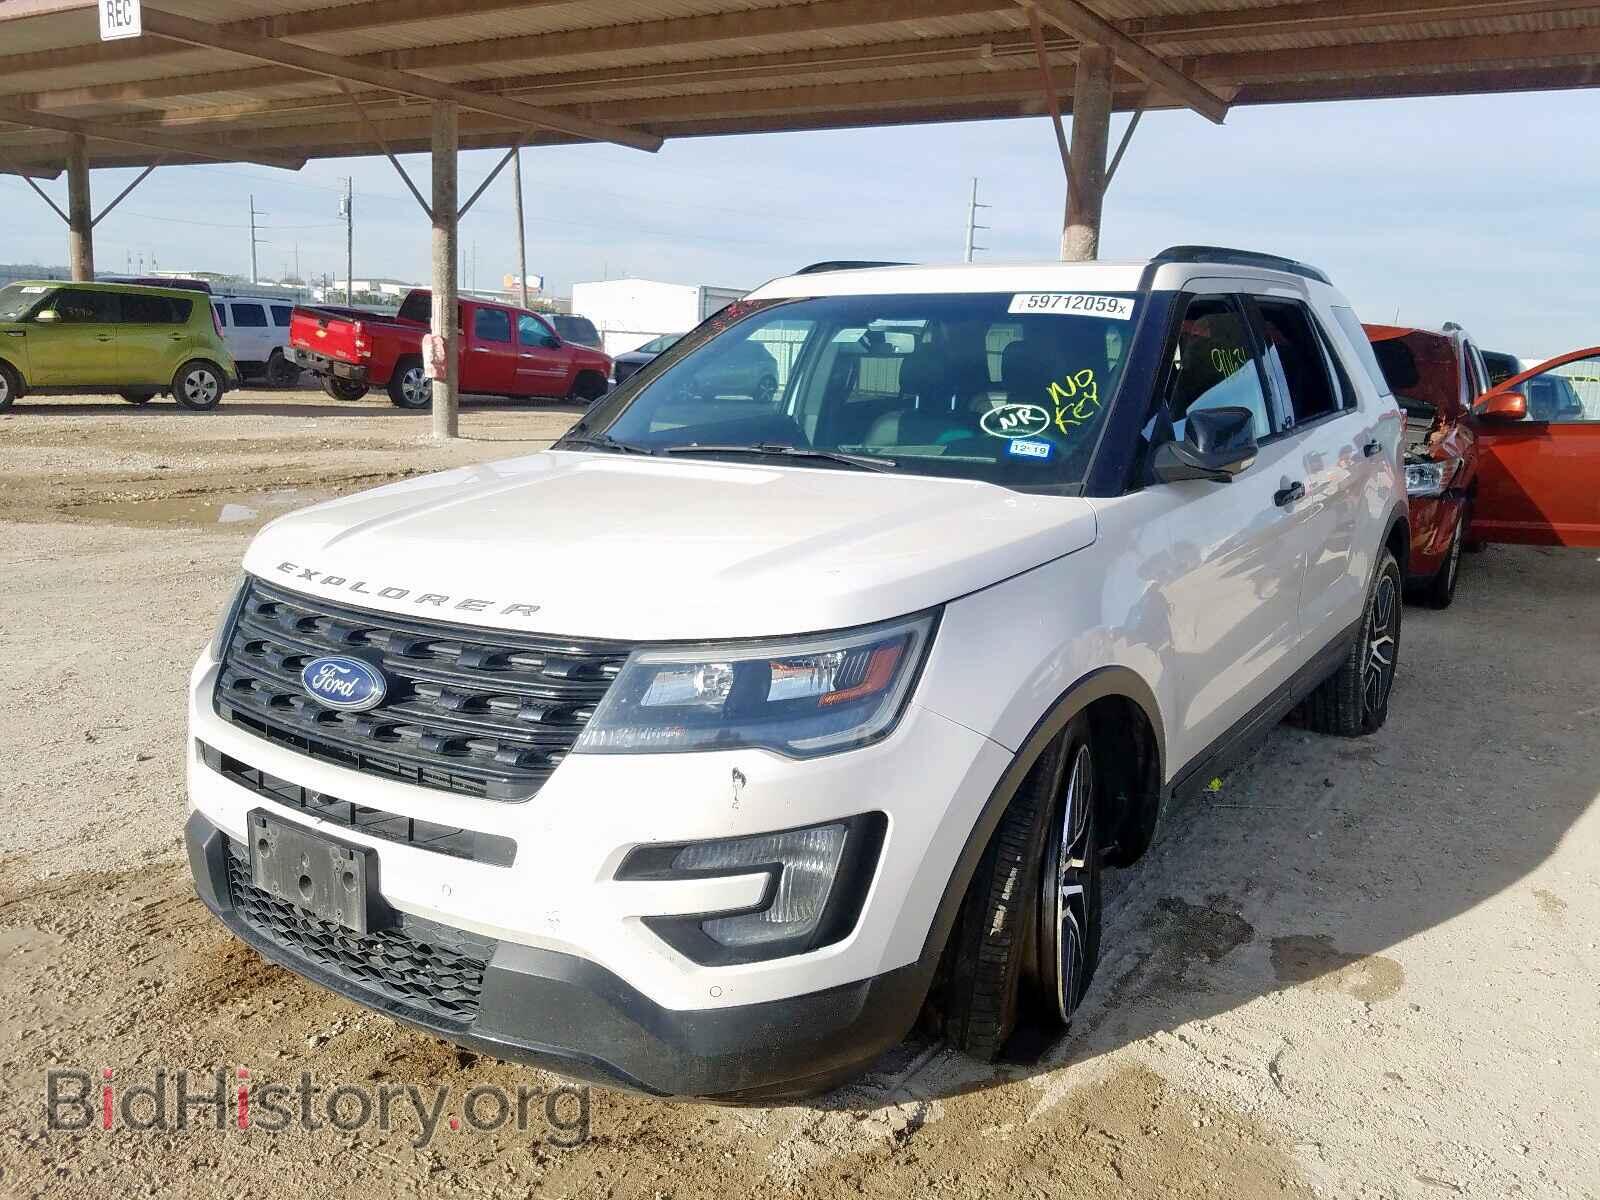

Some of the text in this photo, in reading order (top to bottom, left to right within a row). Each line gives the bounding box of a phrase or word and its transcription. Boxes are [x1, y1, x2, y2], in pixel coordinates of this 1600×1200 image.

[107, 0, 131, 28] REC
[1046, 369, 1093, 405] NO
[999, 408, 1046, 430] NR
[276, 560, 541, 617] EXPLORER
[312, 663, 360, 697] Ford
